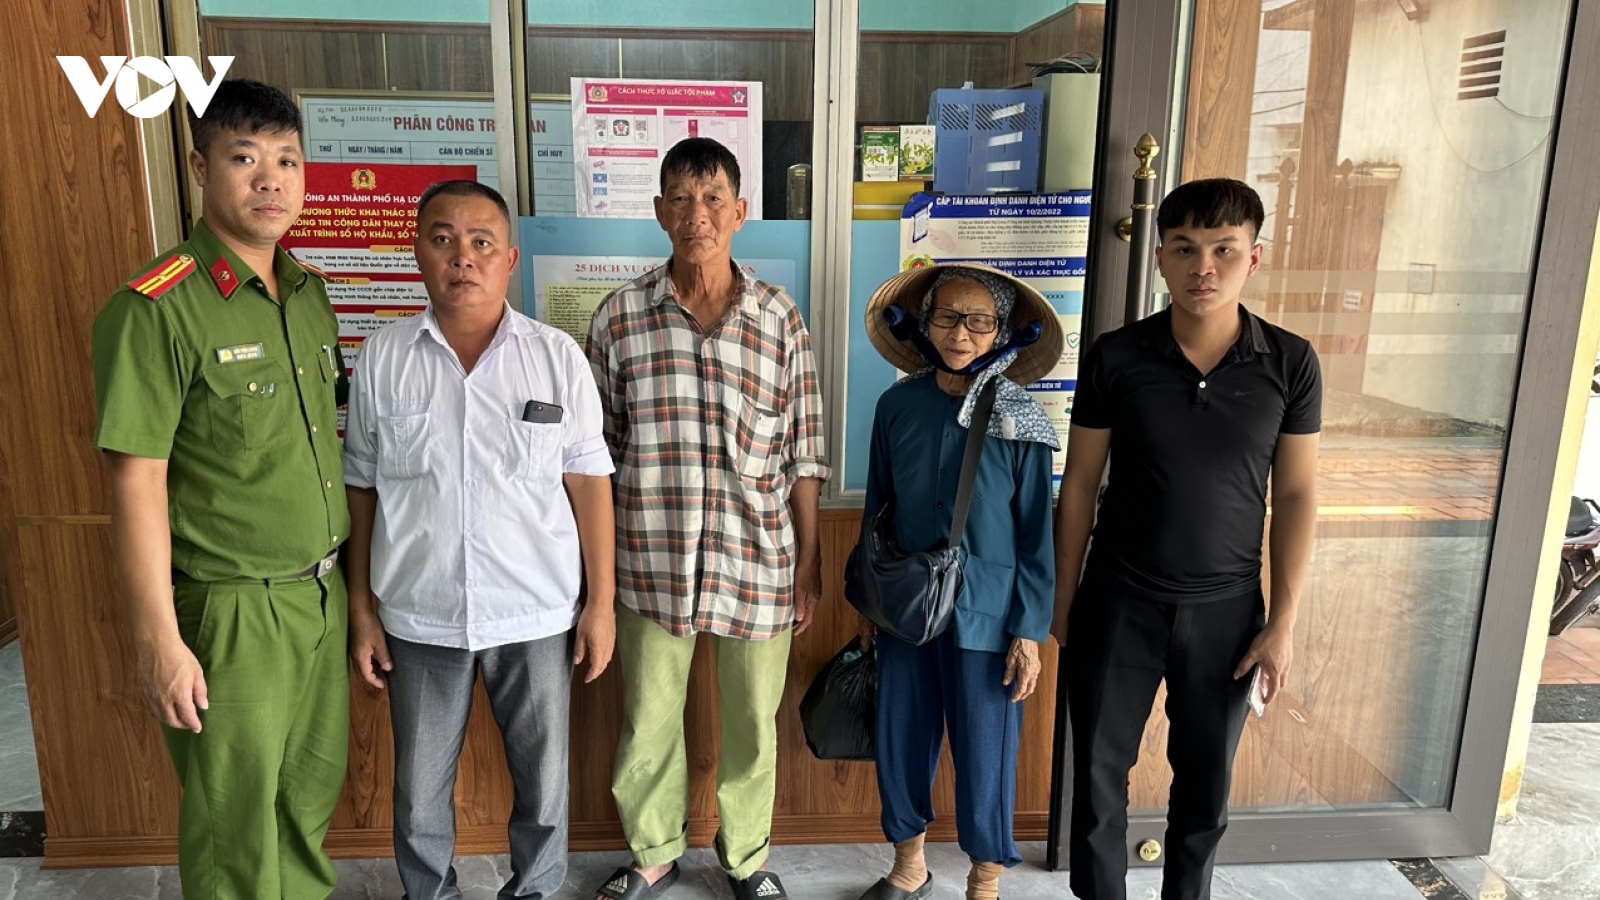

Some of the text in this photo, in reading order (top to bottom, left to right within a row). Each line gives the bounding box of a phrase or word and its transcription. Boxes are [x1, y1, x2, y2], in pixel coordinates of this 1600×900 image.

[394, 114, 432, 130] PHÂN
[436, 114, 474, 132] CÔNG
[478, 118, 496, 132] TR
[531, 120, 546, 133] AN
[319, 144, 333, 152] THỨ
[304, 192, 326, 202] ÔNG
[341, 194, 370, 202] THÀNH
[373, 194, 391, 203] PHỐ
[393, 196, 406, 205] HẠ
[937, 196, 951, 206] CẤP
[1058, 196, 1073, 204] CHO
[300, 207, 332, 216] HƯƠNG
[334, 207, 357, 216] THỨC
[382, 208, 406, 217] THÁC
[1001, 207, 1024, 216] NGÀY
[1026, 208, 1062, 216] 10/2/2022
[294, 218, 316, 226] ÔNG
[334, 217, 360, 227] CÔNG
[362, 218, 381, 227] DÂN
[383, 220, 404, 228] THAY
[406, 220, 418, 228] CH
[289, 228, 312, 237] XUẤT
[313, 228, 338, 237] TRÌNH
[354, 229, 367, 239] HỘ
[1038, 259, 1055, 268] ĐIỆN
[574, 264, 586, 272] 25
[589, 264, 619, 274] DỊCH
[623, 265, 639, 275] VỤ
[643, 263, 658, 273] CÔ
[1052, 269, 1071, 277] THỰC
